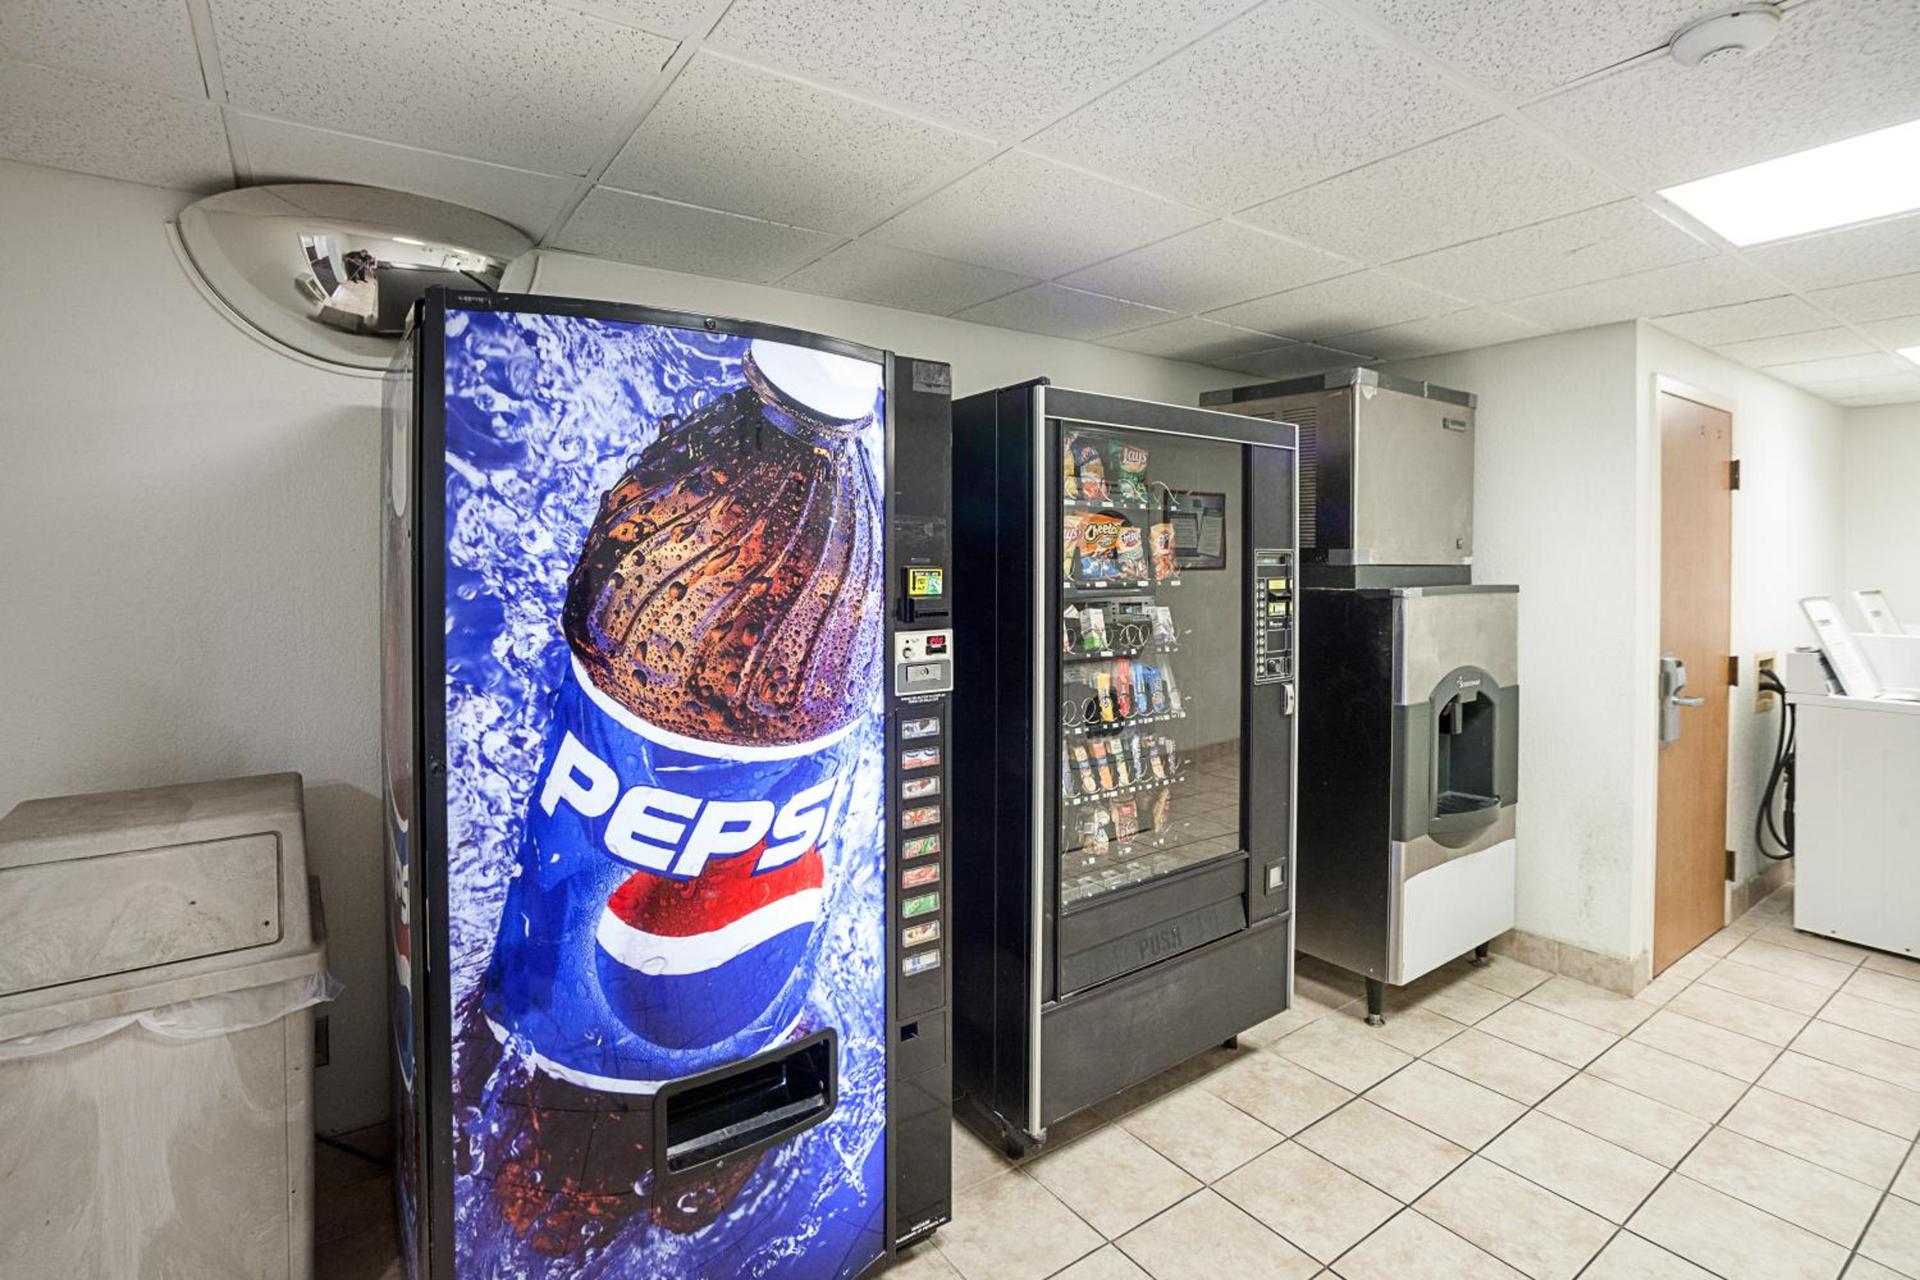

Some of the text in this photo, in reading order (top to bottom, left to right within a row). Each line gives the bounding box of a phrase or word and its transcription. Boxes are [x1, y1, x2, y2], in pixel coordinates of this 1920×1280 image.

[1084, 522, 1119, 541] Cheeto
[540, 730, 846, 877] PEPSI
[1139, 926, 1182, 960] PUSH
